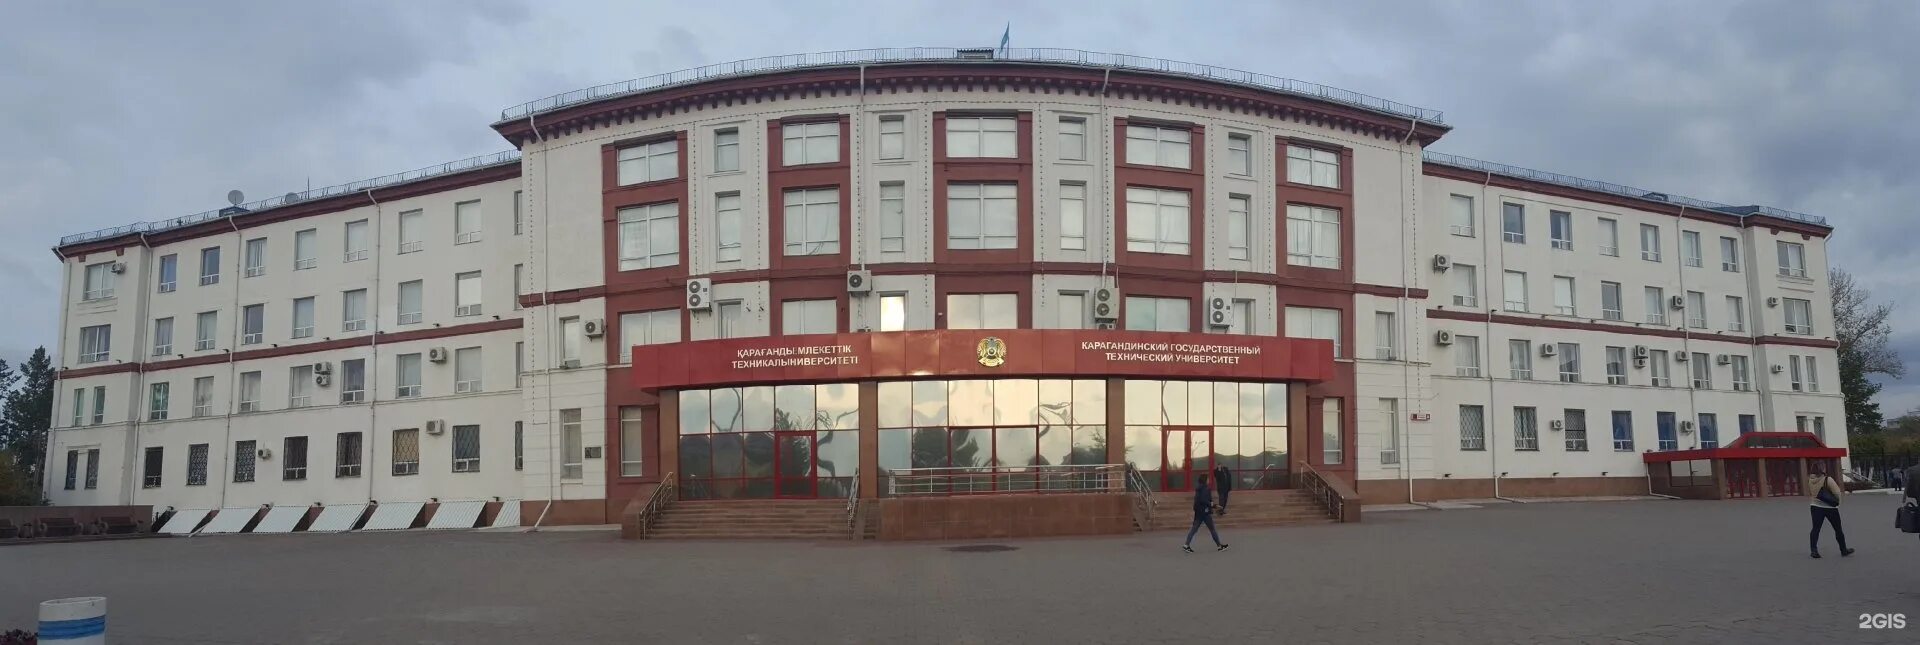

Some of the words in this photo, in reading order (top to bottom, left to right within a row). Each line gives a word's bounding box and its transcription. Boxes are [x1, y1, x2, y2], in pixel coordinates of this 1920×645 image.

[1081, 341, 1169, 351] КАРАГАНДИНСКИЙ
[1170, 344, 1261, 355] ГОСУДАРСТВЕННЫЙ
[1105, 352, 1174, 362] ТЕХНИЧЕСКИЙ
[1175, 354, 1240, 365] УНИВЕРСИТЕТ
